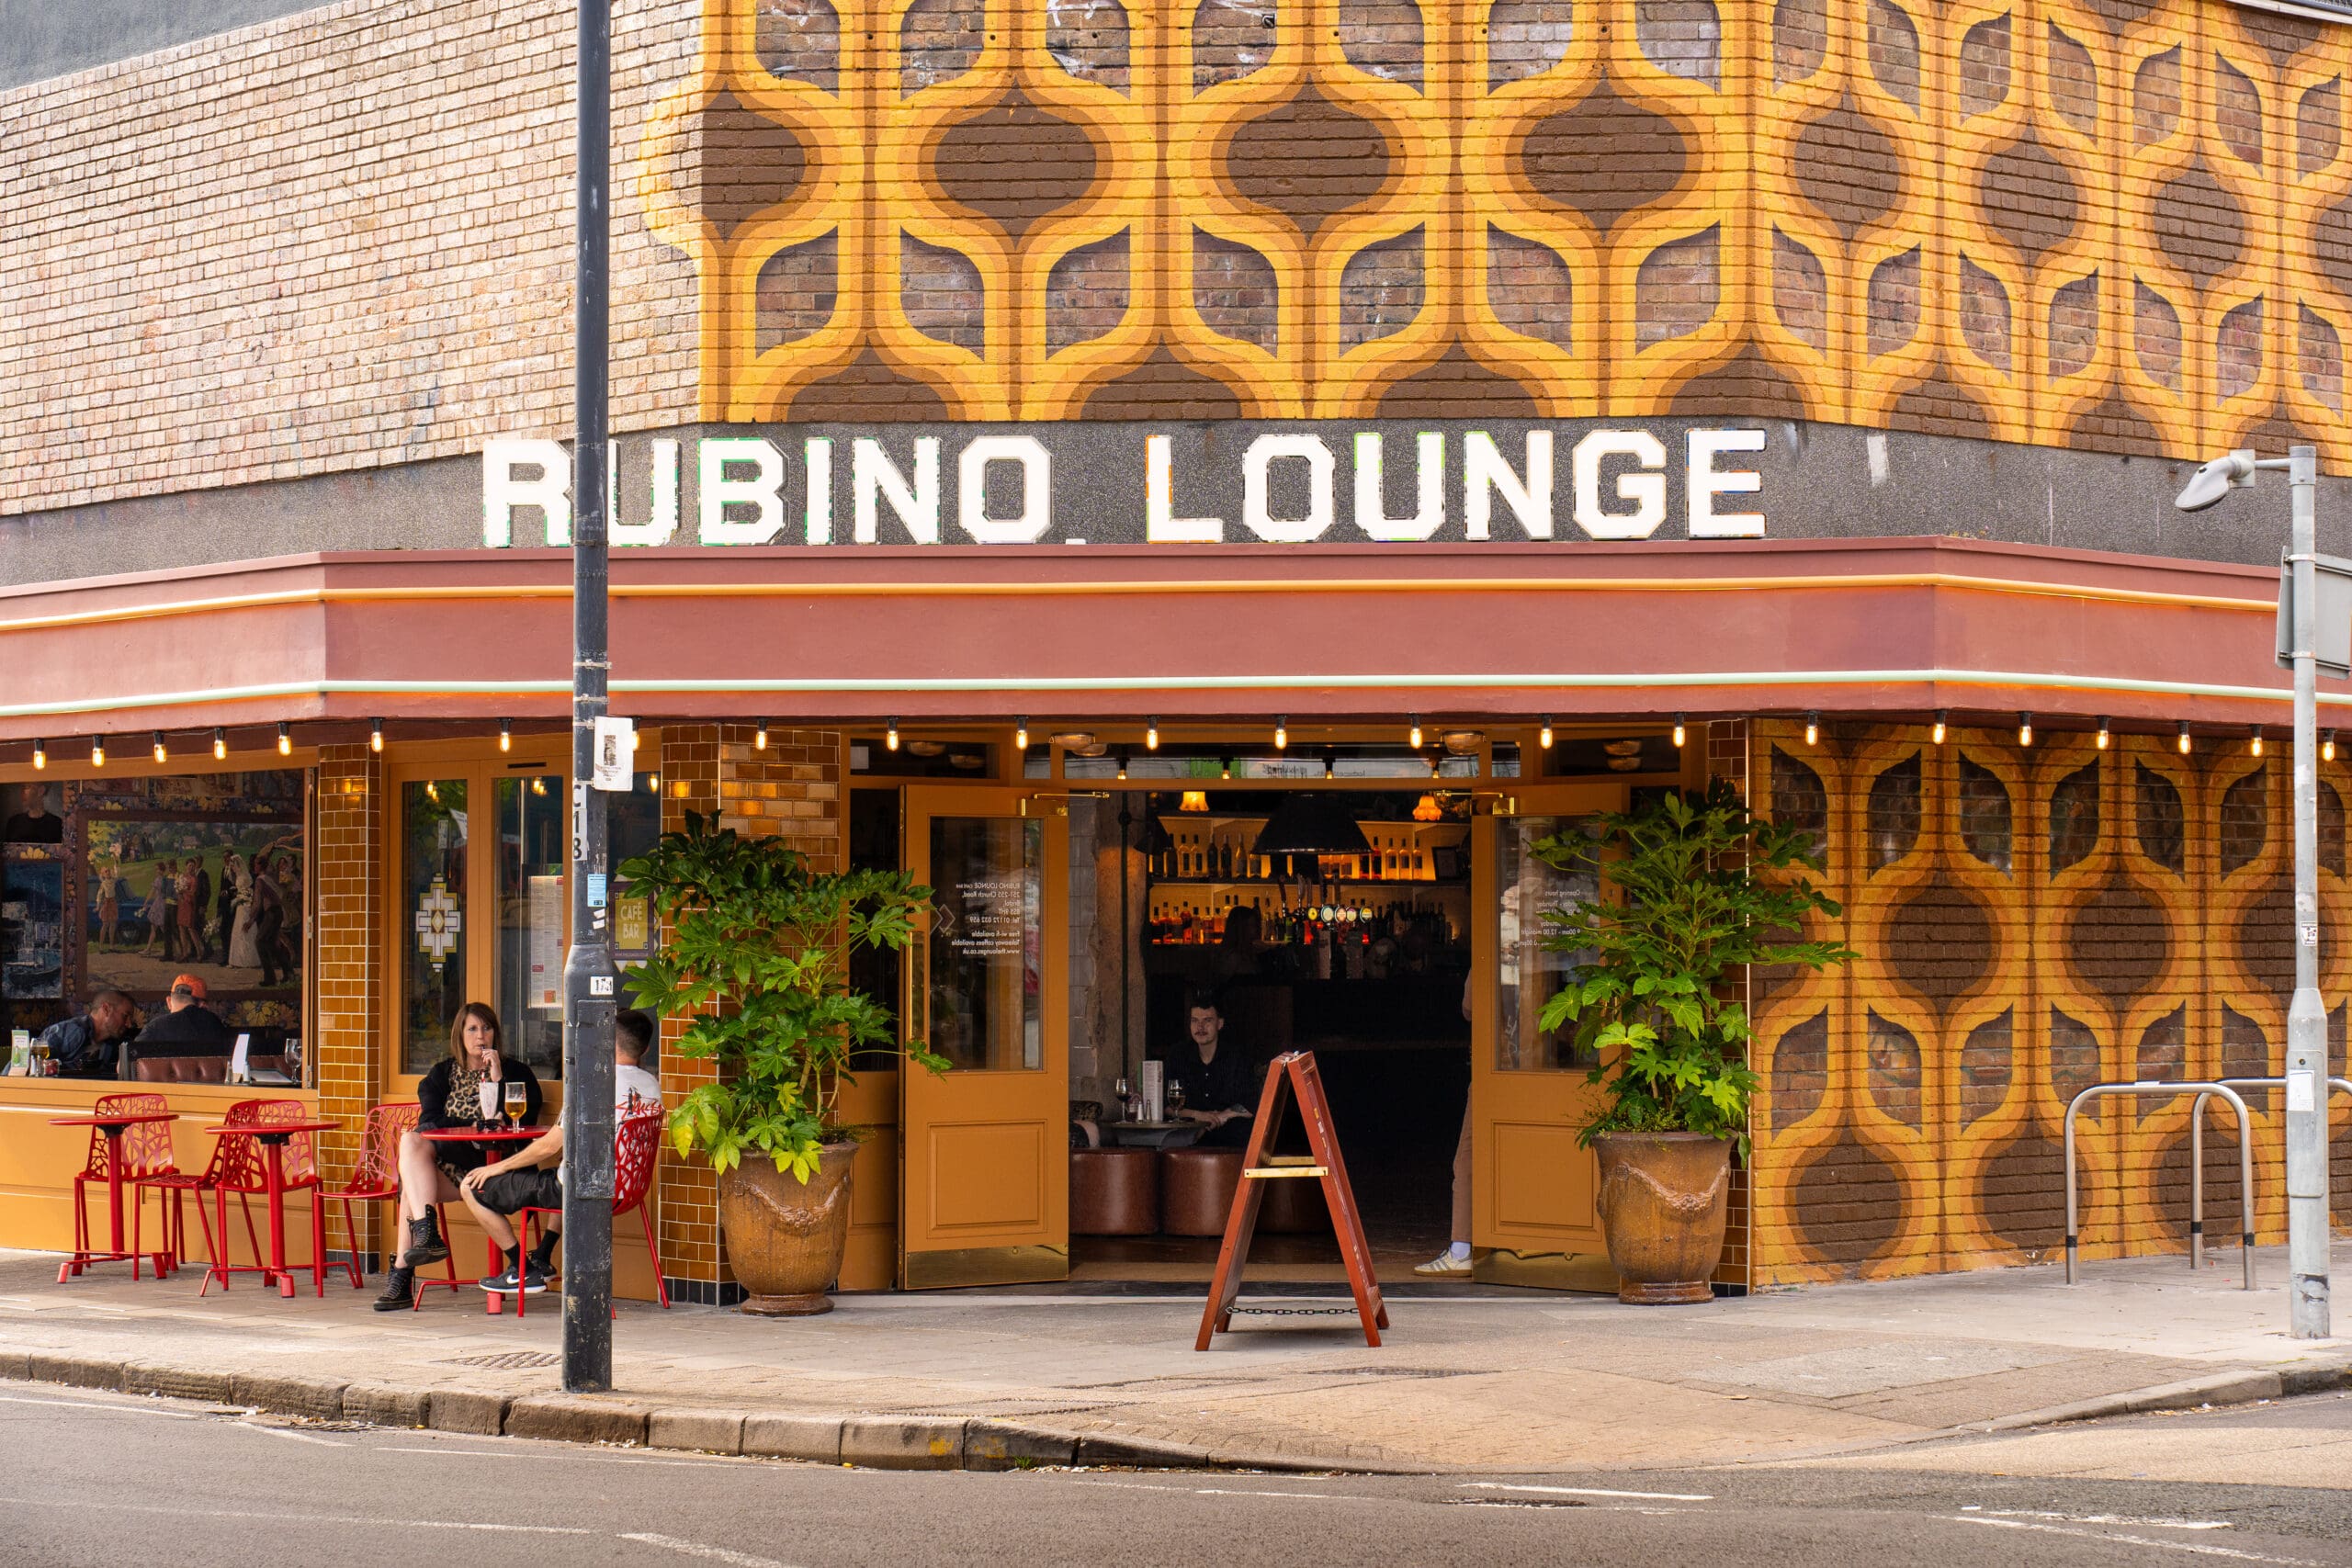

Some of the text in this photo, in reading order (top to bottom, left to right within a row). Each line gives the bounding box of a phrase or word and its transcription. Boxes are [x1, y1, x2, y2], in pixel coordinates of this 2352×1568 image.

[1146, 429, 1767, 543] LOUNGE
[620, 902, 643, 920] CAFÉ
[623, 923, 639, 939] BAR
